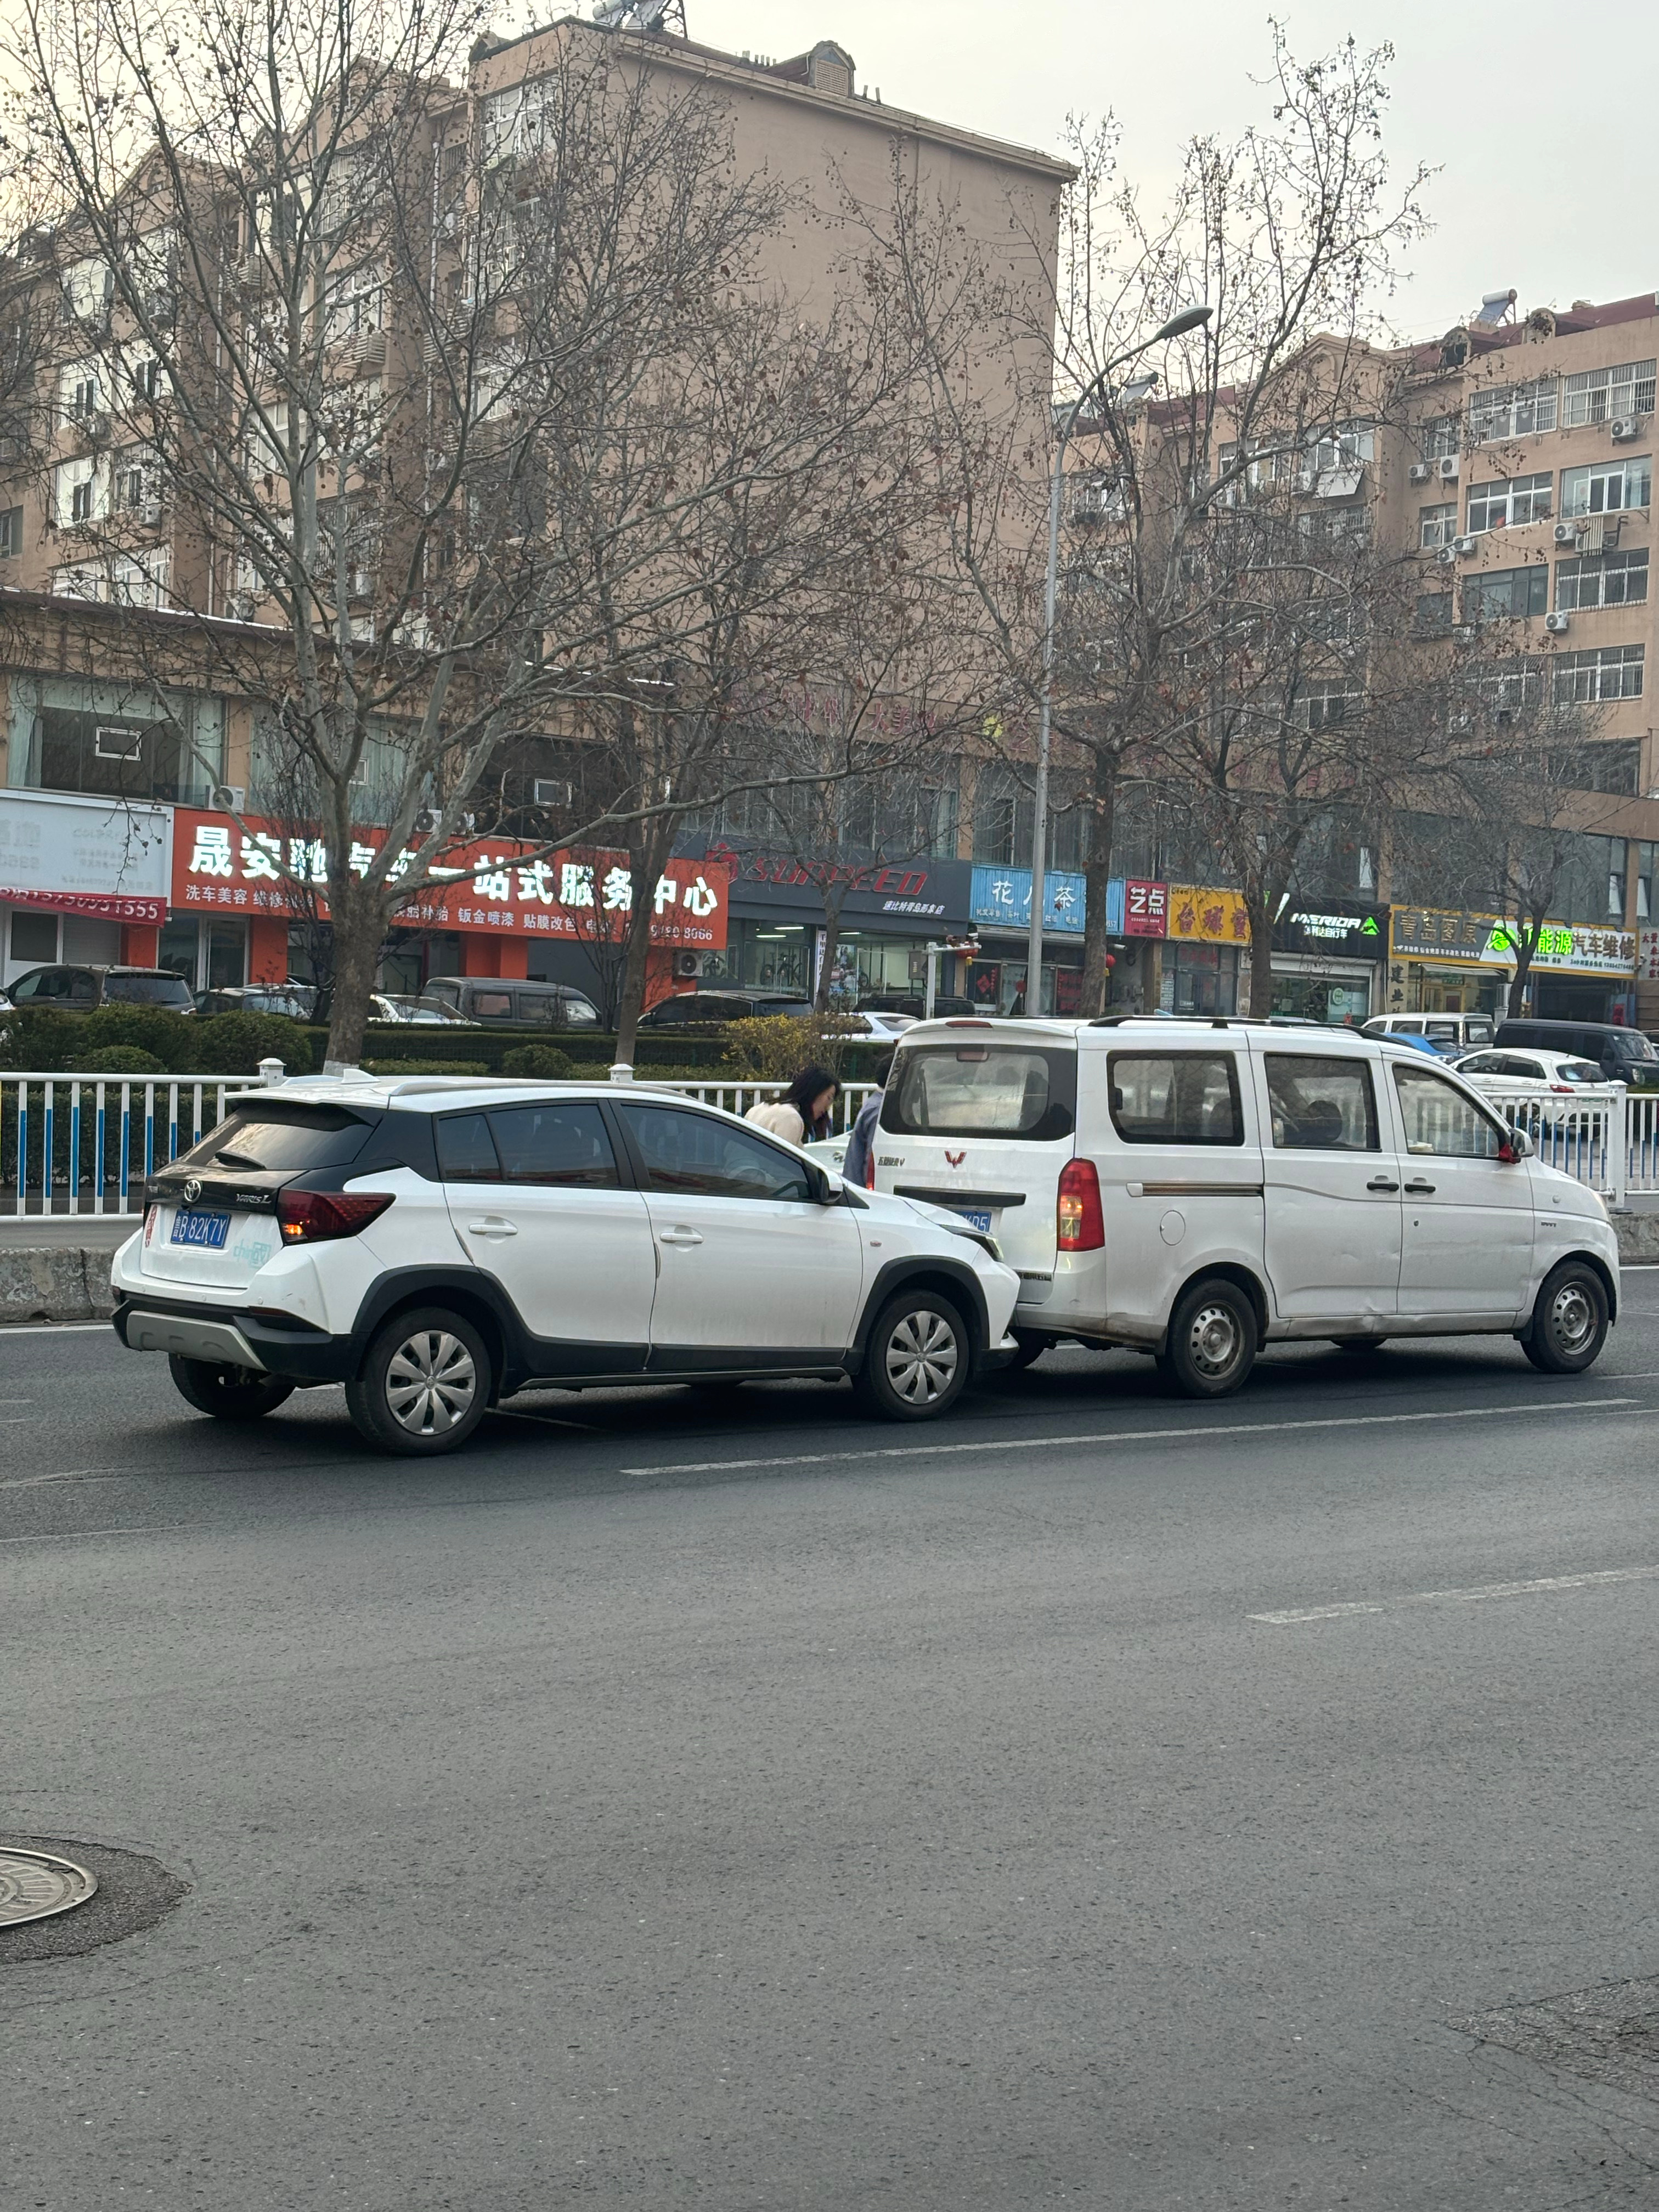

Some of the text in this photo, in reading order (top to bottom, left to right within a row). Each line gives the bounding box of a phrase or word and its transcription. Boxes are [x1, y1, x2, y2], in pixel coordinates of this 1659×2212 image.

[186, 884, 247, 905] 洗车美容
[458, 907, 515, 927] 钣金喷漆
[523, 914, 577, 932] 贴膜改色
[1290, 913, 1361, 929] MERIDA
